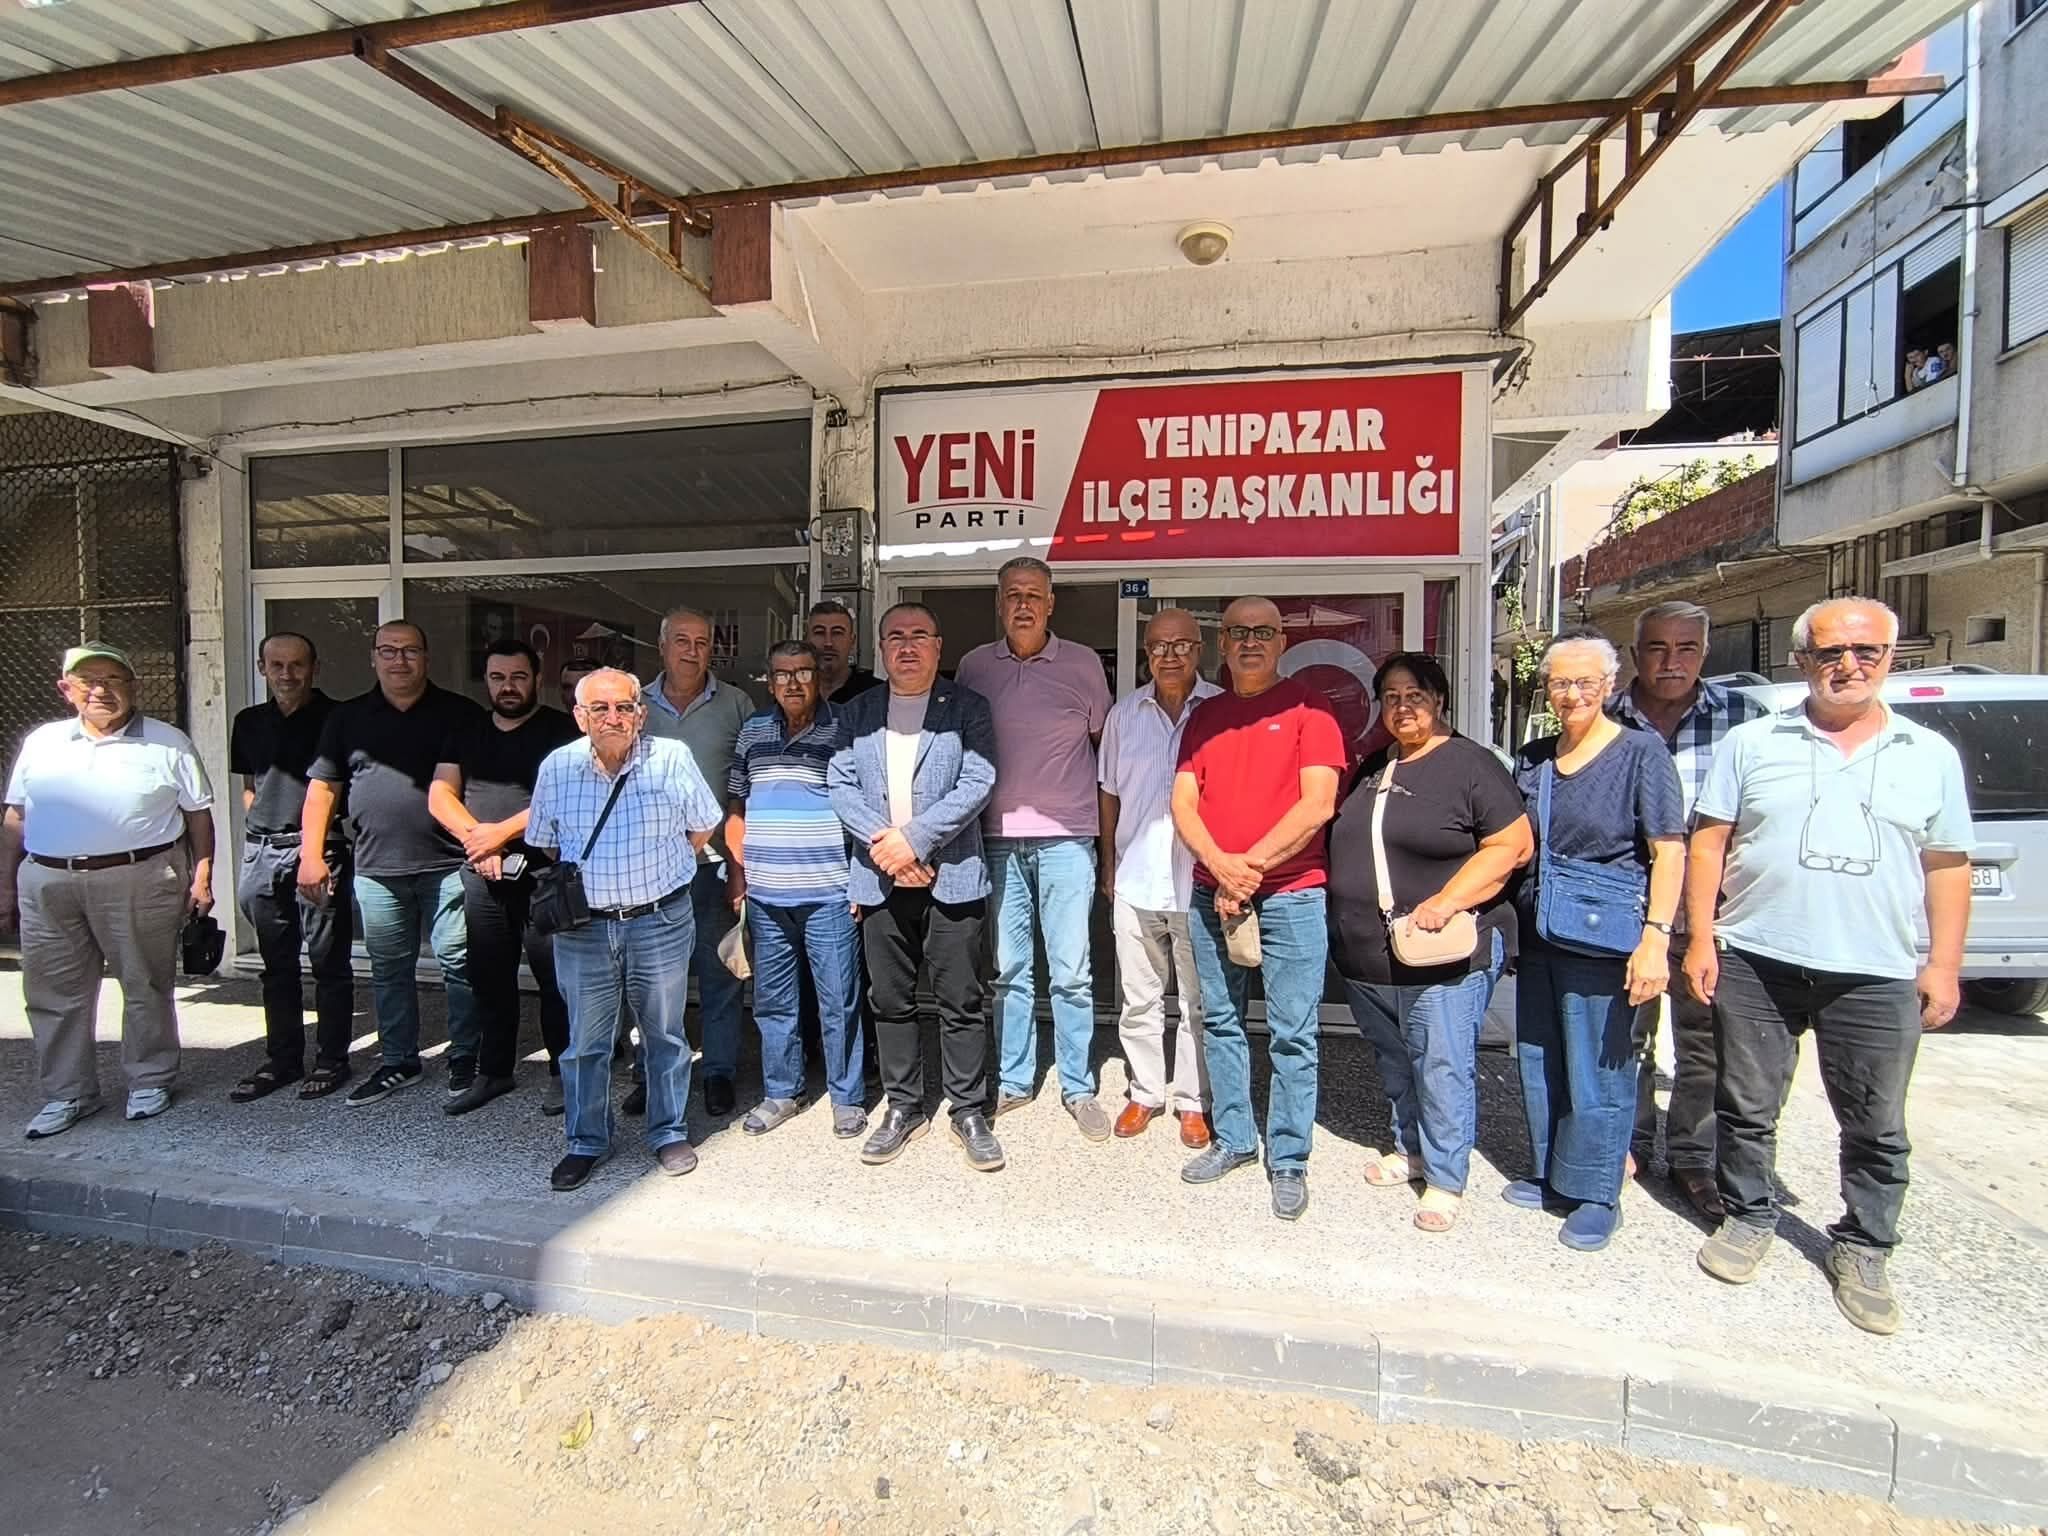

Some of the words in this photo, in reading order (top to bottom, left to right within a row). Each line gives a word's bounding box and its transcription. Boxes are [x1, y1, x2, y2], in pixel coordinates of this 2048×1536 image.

[1137, 408, 1386, 459] YENİPAZAR
[893, 428, 1035, 504] YENİ
[1082, 479, 1172, 527] İLÇE
[1181, 456, 1454, 525] BAŞKANLIĞI
[915, 510, 1025, 529] PARTİ
[1125, 583, 1139, 593] 36
